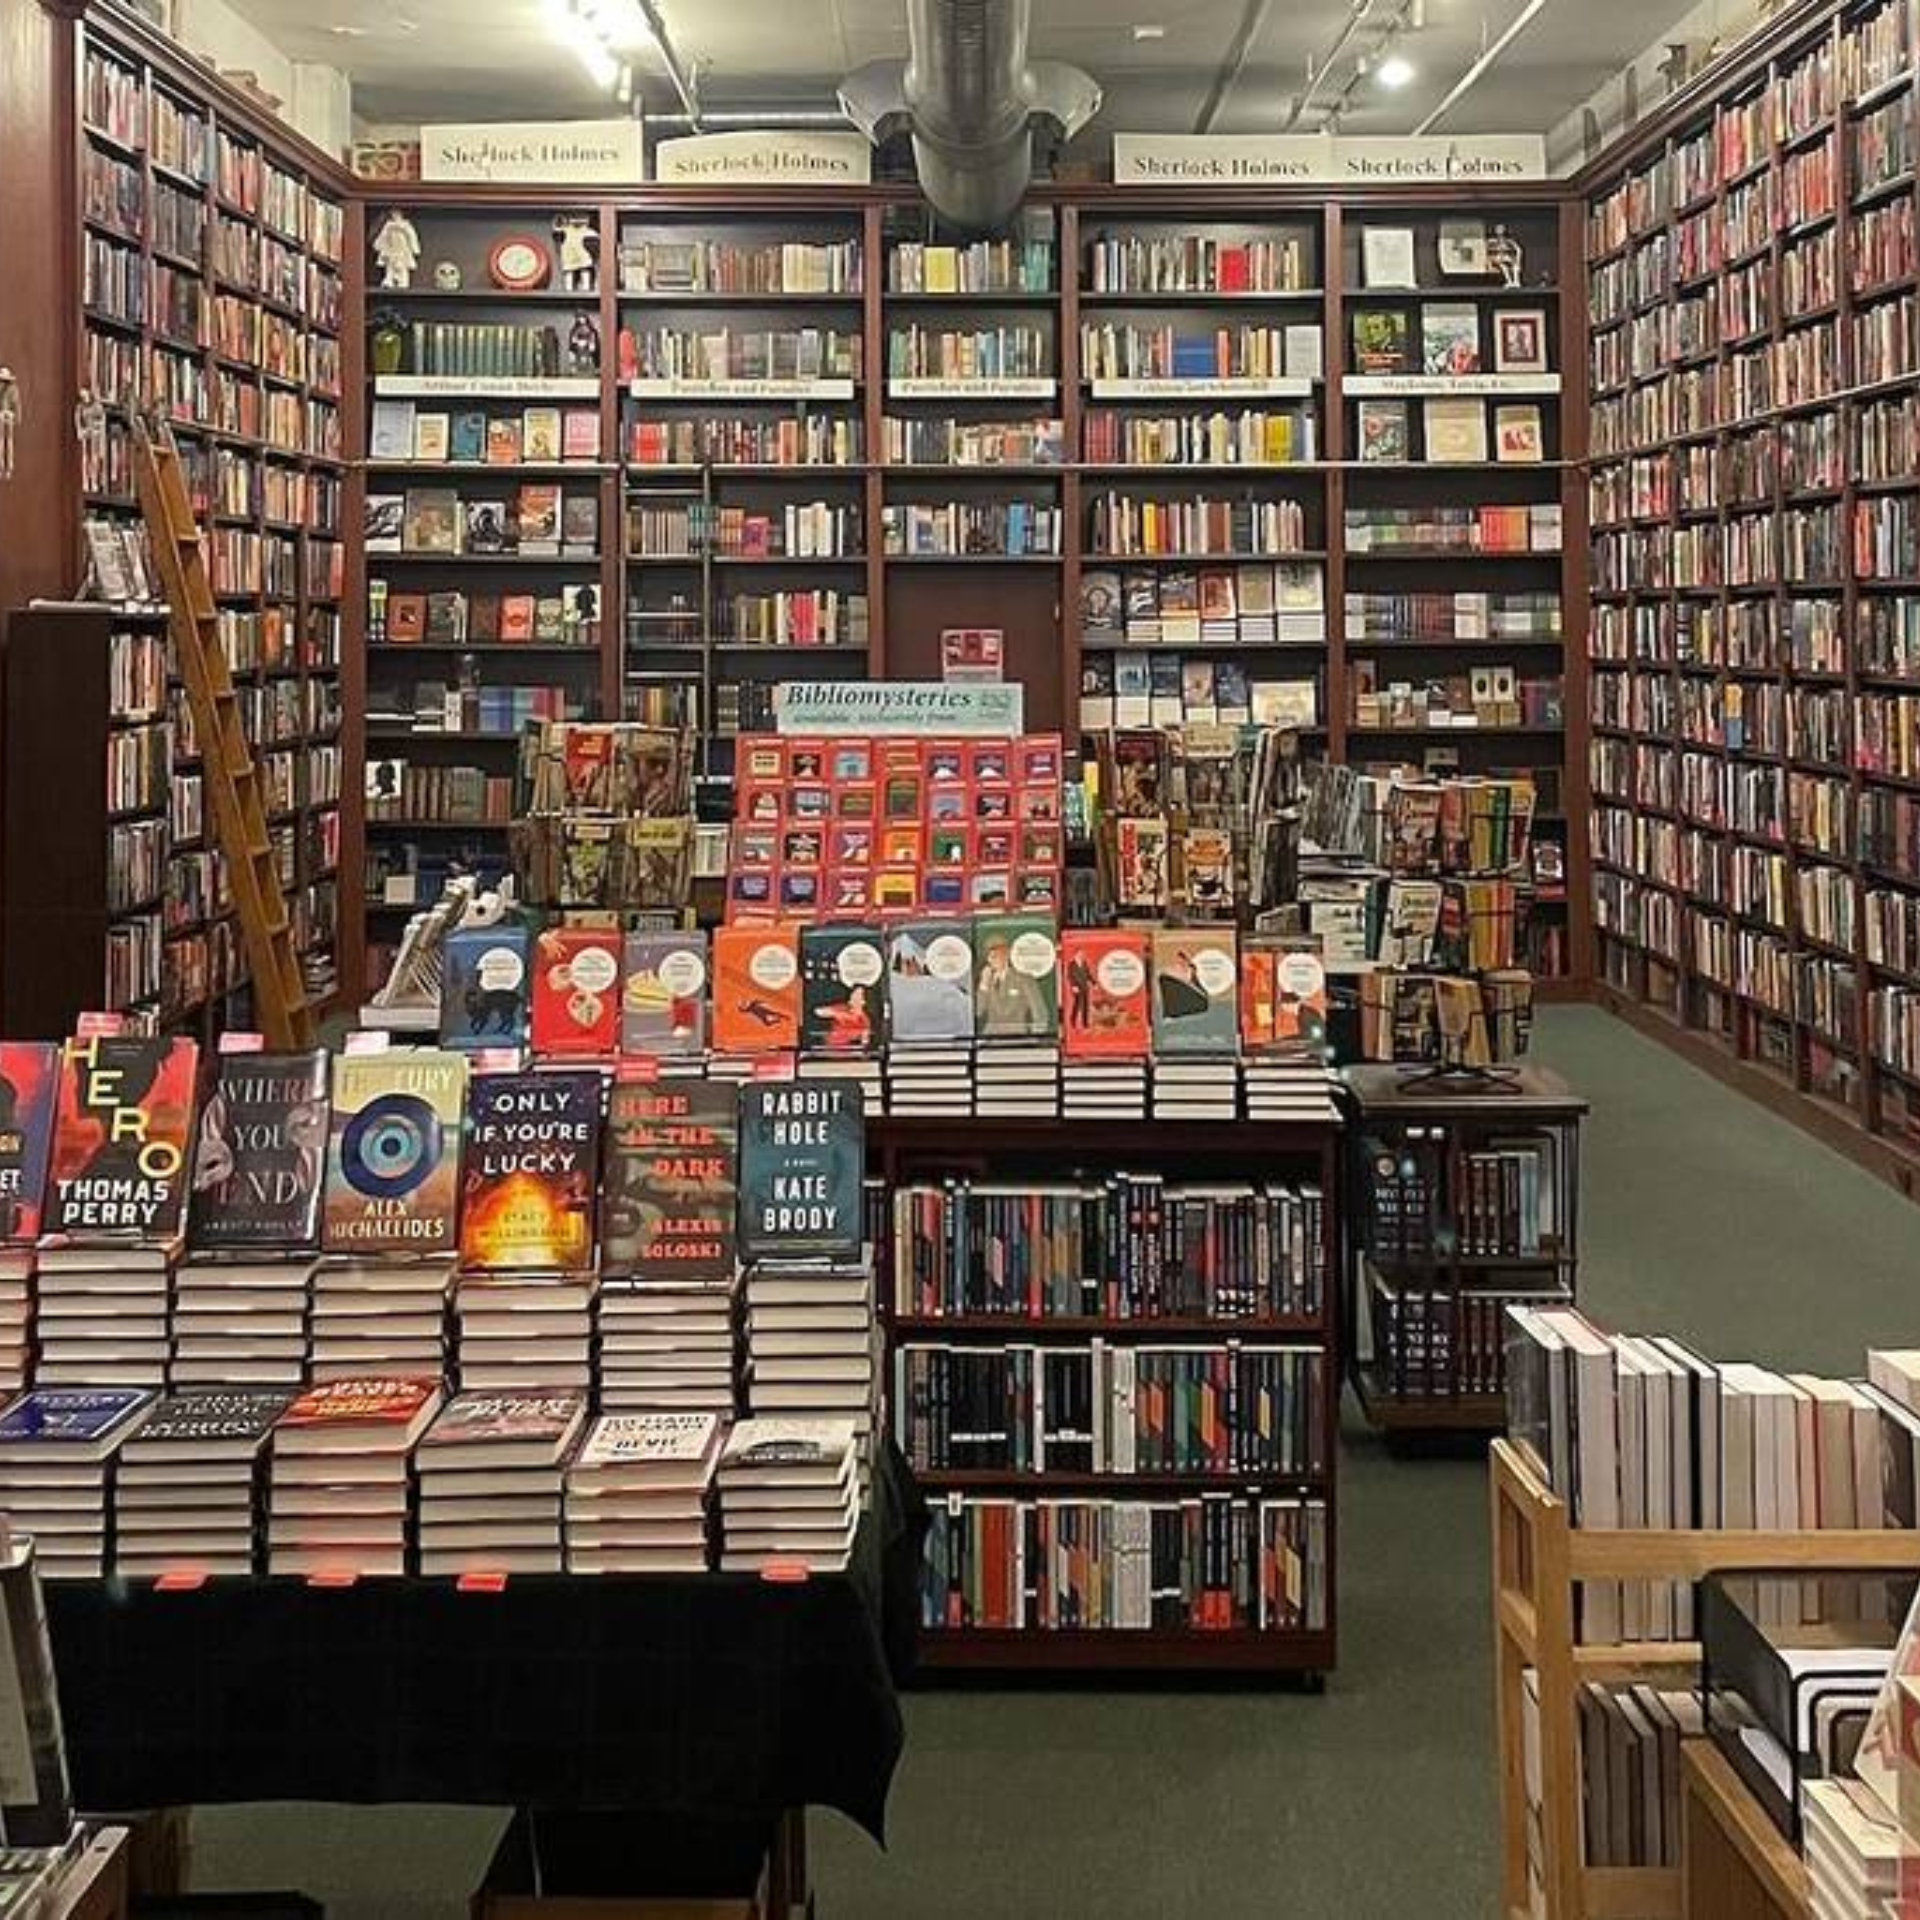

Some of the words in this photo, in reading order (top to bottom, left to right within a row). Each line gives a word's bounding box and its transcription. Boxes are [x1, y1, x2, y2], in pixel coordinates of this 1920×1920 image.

[442, 145, 533, 164] Shelock
[541, 144, 618, 161] Holmes
[675, 154, 764, 174] Sherlock
[773, 152, 849, 171] Holmes
[1134, 156, 1223, 176] Sherlock
[1231, 158, 1310, 176] Holmes
[1347, 156, 1435, 175] Sherlock
[787, 684, 972, 712] Bibliomysteries
[218, 1078, 311, 1103] WHERE
[58, 1036, 182, 1179] HERO
[495, 1093, 571, 1113] ONLY
[763, 1090, 842, 1117] RABBIT
[234, 1124, 286, 1150] YOU
[475, 1126, 497, 1143] IF
[503, 1123, 589, 1143] YOU'RE
[774, 1121, 829, 1146] HOLE
[483, 1153, 577, 1175] LUCKY
[654, 1158, 725, 1178] DARK
[57, 1179, 170, 1201] THOMAS
[774, 1176, 827, 1200] KATE
[62, 1203, 159, 1224] PERRY
[364, 1199, 408, 1218] ALEX
[764, 1207, 838, 1232] BRODY
